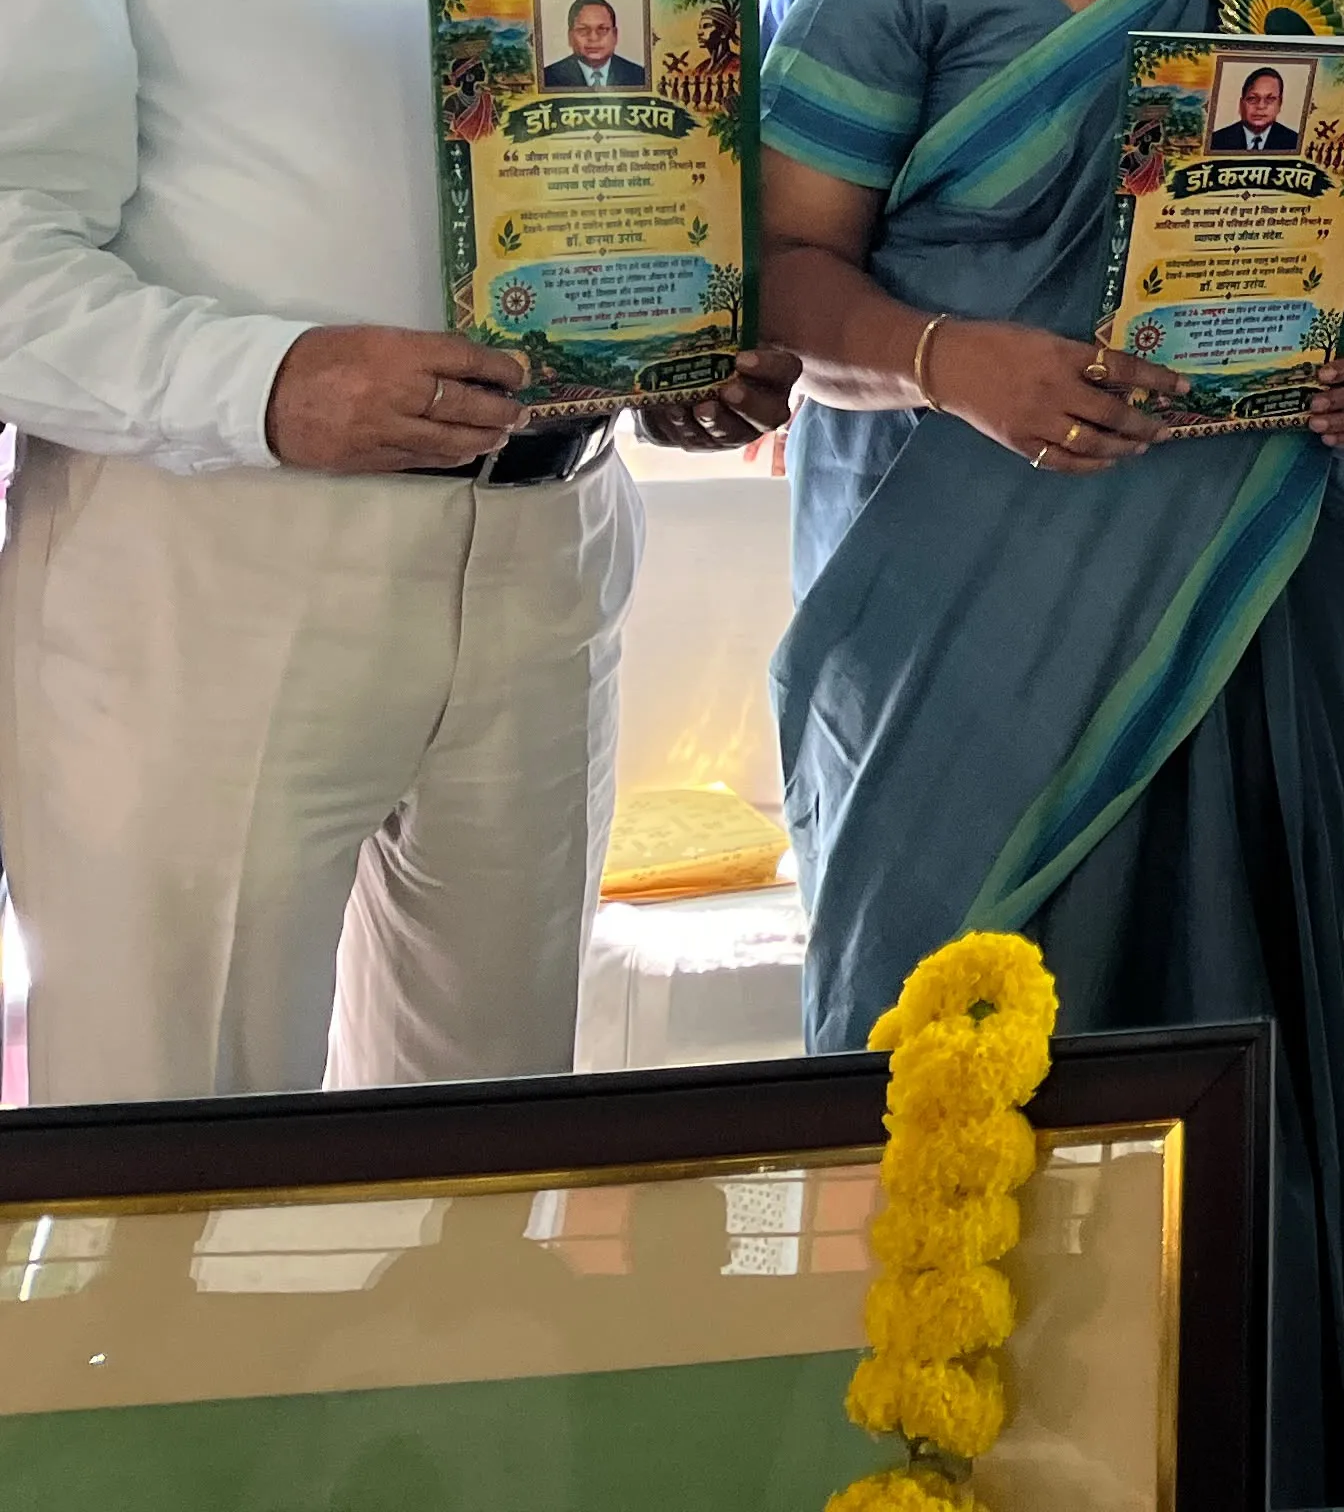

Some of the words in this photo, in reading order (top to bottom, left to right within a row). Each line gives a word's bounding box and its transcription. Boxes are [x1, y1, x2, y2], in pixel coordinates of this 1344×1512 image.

[523, 102, 557, 135] डॉ.
[559, 104, 623, 128] करमा
[624, 99, 675, 131] उरांव
[1186, 164, 1214, 191] डॉ.
[1217, 166, 1273, 186] करमा
[1273, 162, 1317, 190] उरांव
